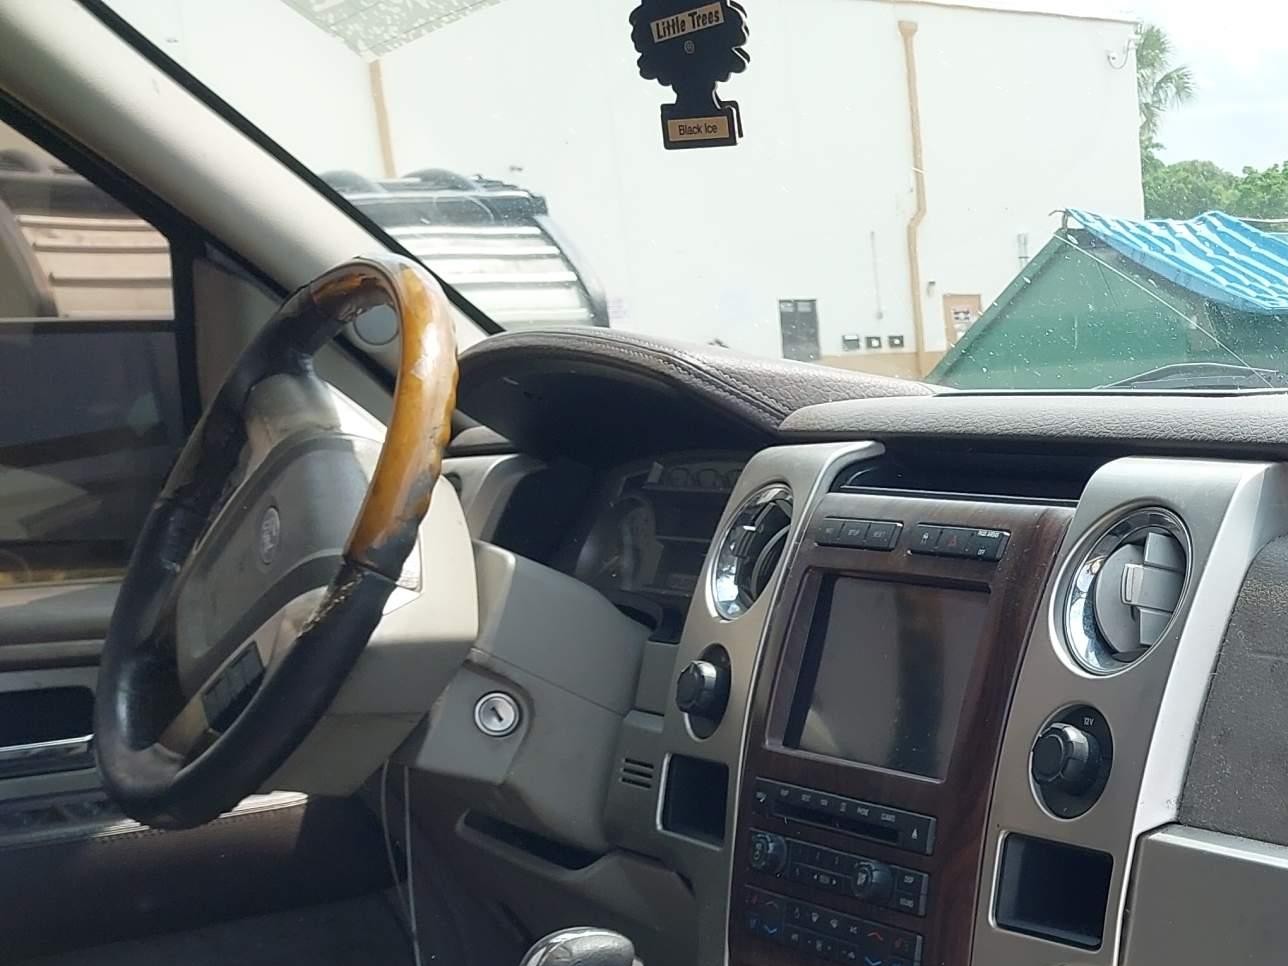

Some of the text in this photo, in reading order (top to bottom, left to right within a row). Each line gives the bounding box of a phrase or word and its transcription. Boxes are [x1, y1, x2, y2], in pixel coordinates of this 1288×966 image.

[656, 10, 720, 40] Little Trees
[678, 123, 718, 136] Black Ice
